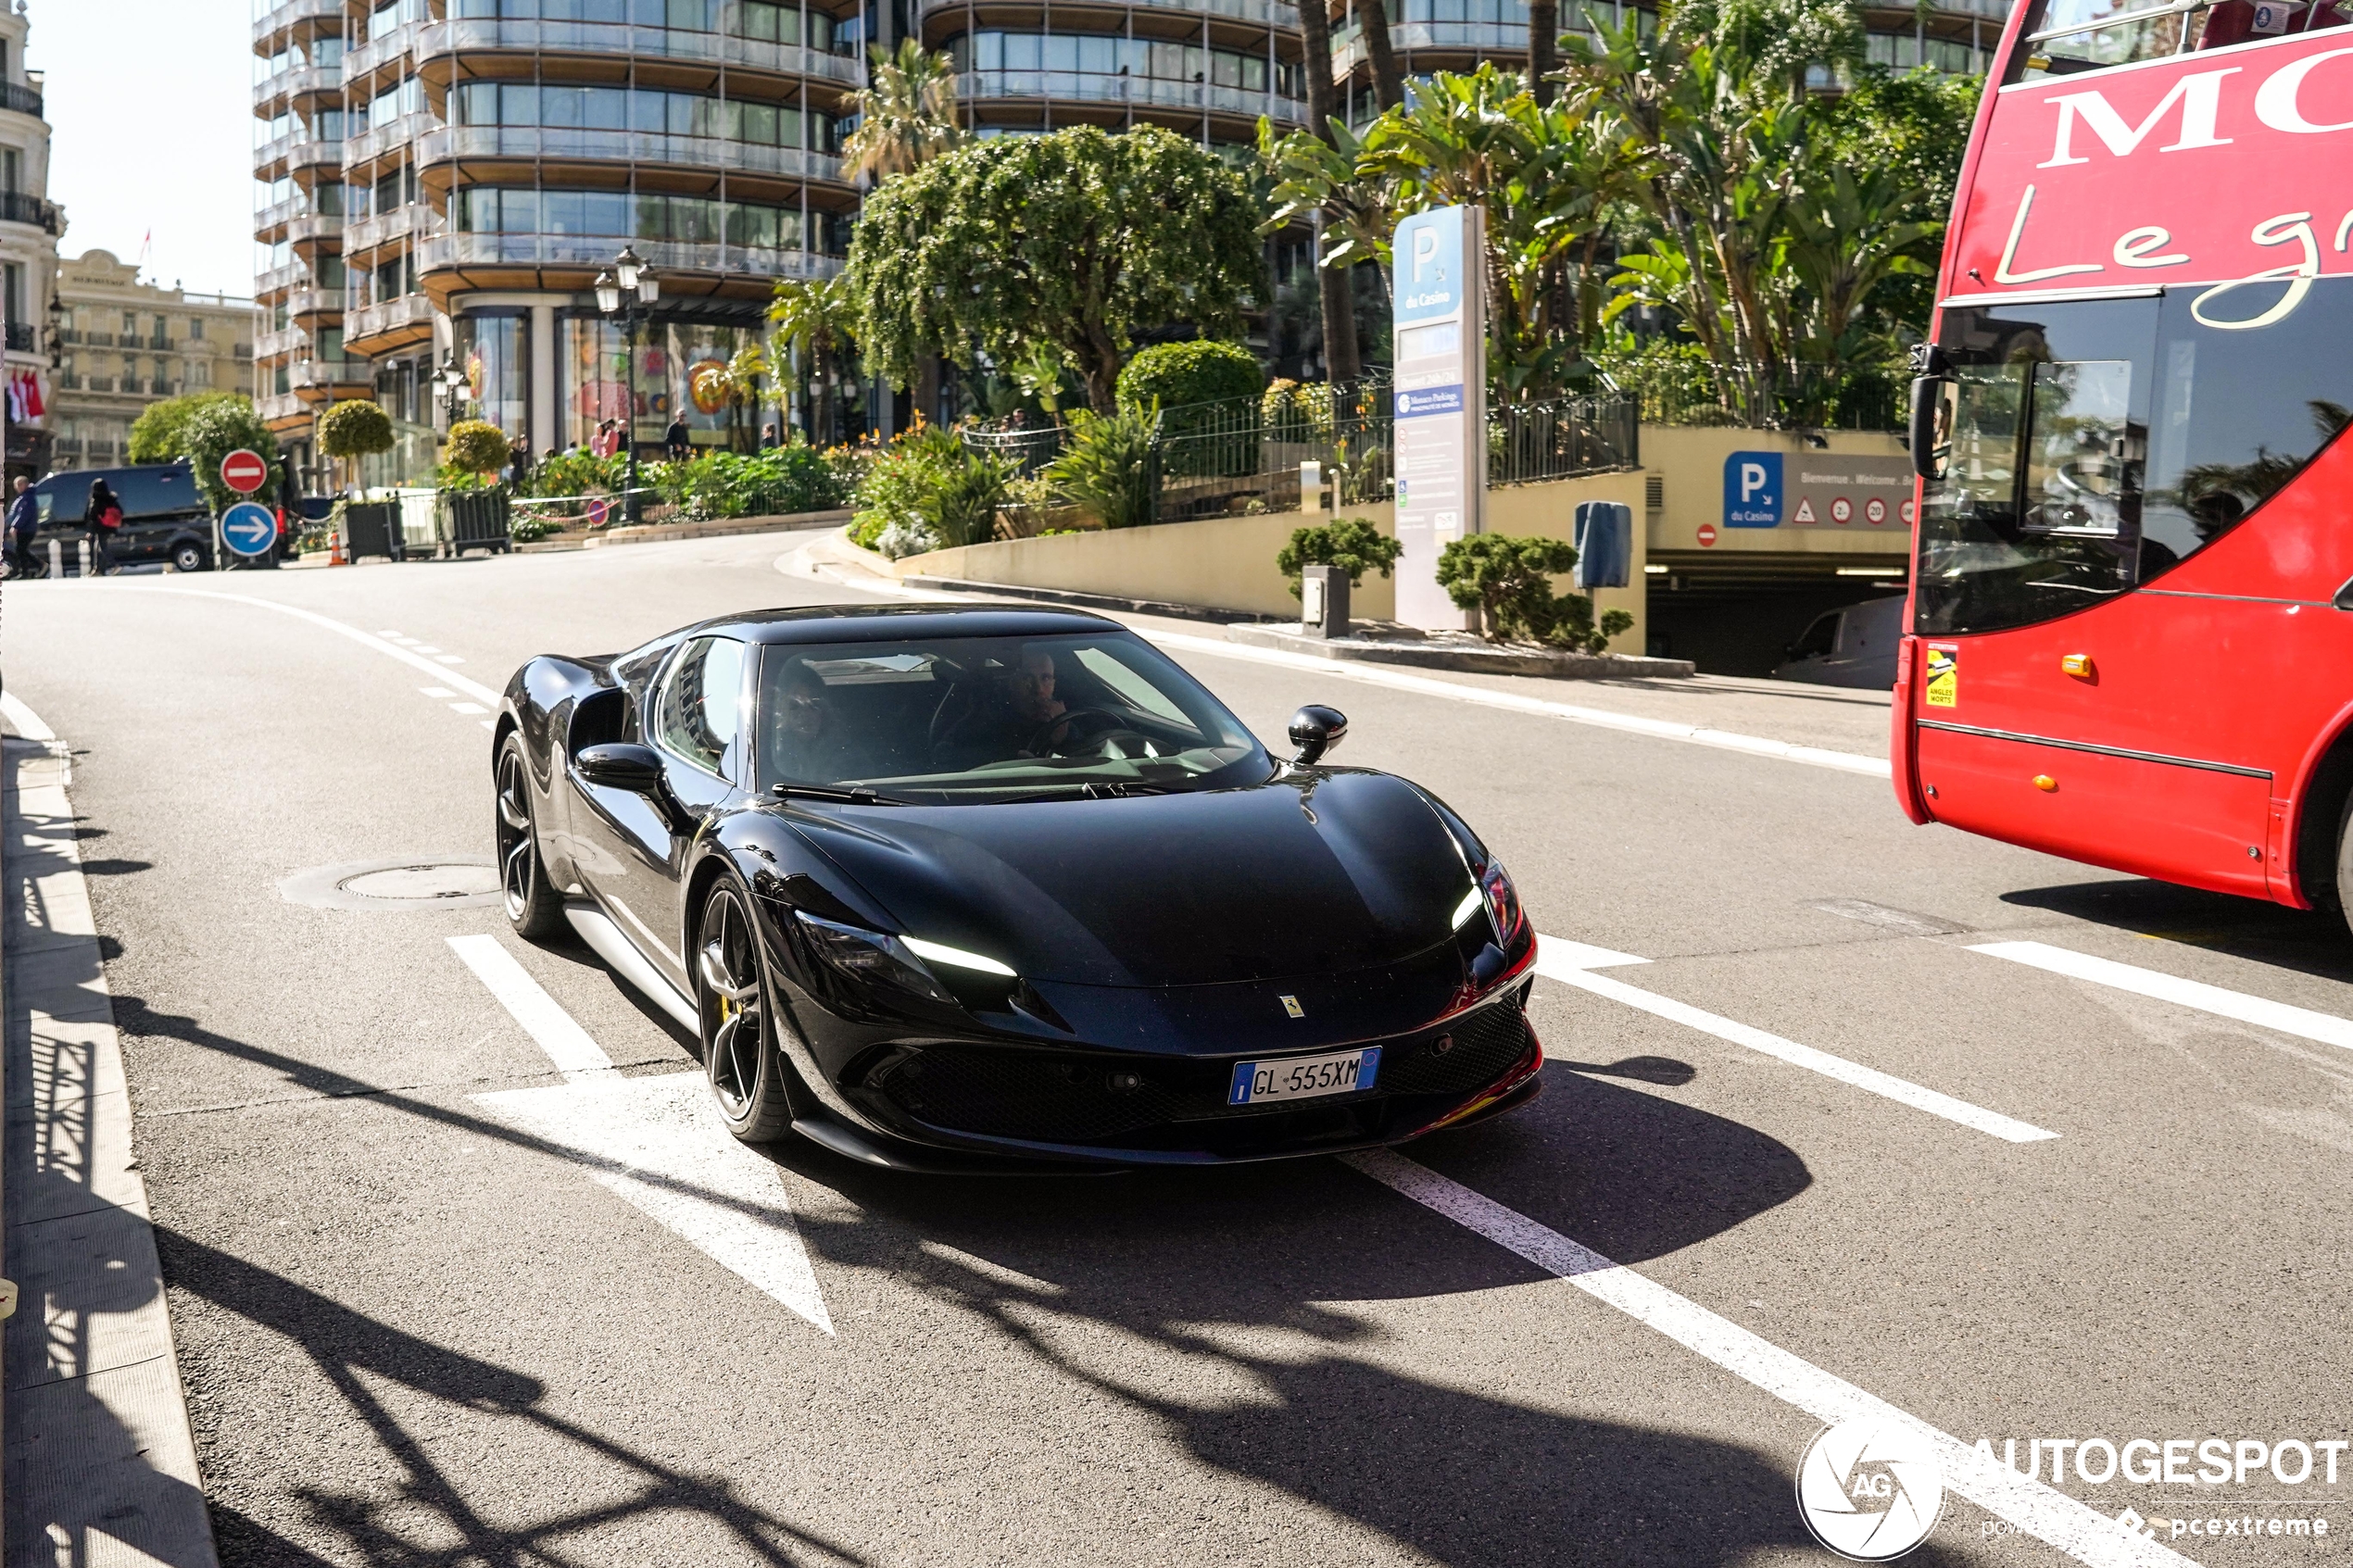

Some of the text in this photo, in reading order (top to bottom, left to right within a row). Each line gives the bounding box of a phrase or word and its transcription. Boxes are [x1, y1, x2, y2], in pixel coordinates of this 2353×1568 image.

[1994, 184, 2192, 286] Le
[1413, 226, 1440, 283] P
[1405, 291, 1451, 309] du Casino
[1741, 463, 1767, 503] P
[1801, 471, 1848, 484] Bienvenue
[1856, 473, 1896, 486] Welcome
[1731, 510, 1774, 523] du Casino
[1870, 506, 1881, 516] 20
[1930, 688, 1953, 696] ANGLES
[1931, 696, 1952, 704] MORTS
[1252, 1058, 1362, 1096] GL 555XM
